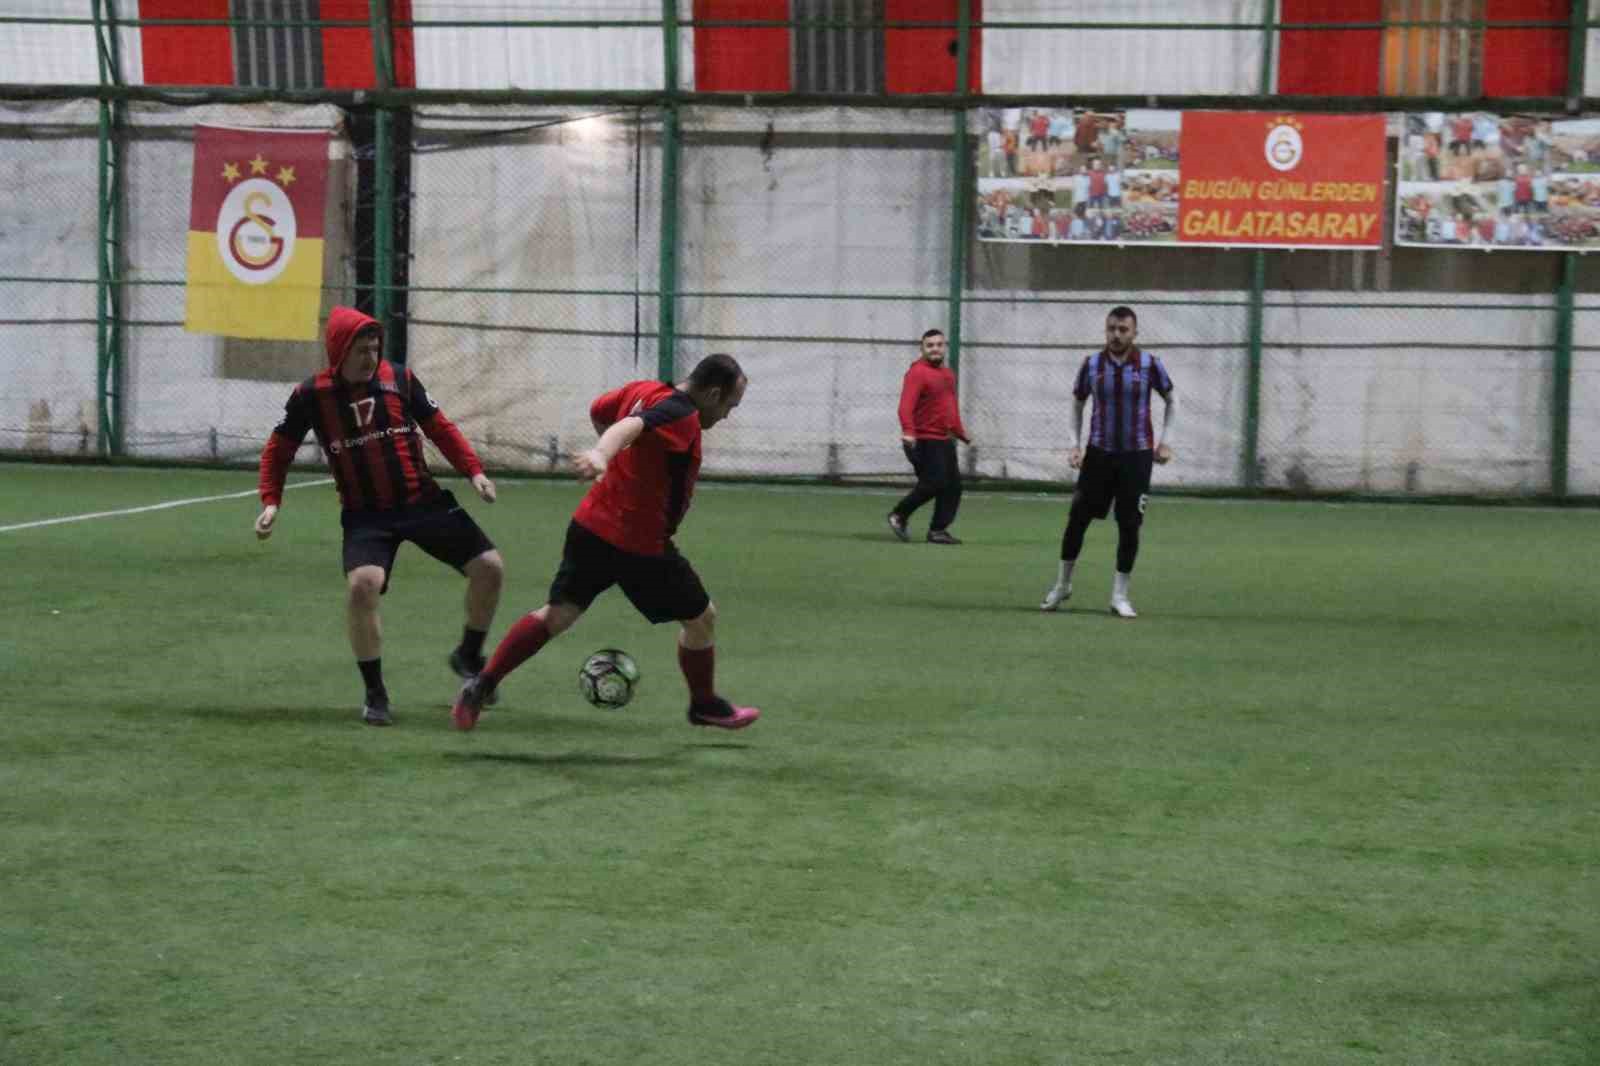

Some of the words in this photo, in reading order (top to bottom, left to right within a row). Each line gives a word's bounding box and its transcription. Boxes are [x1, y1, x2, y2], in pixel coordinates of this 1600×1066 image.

[1184, 177, 1253, 200] BUGÜN
[1257, 178, 1377, 202] GÜNLERDEN
[1183, 208, 1377, 239] GALATASARAY
[349, 397, 377, 428] 17
